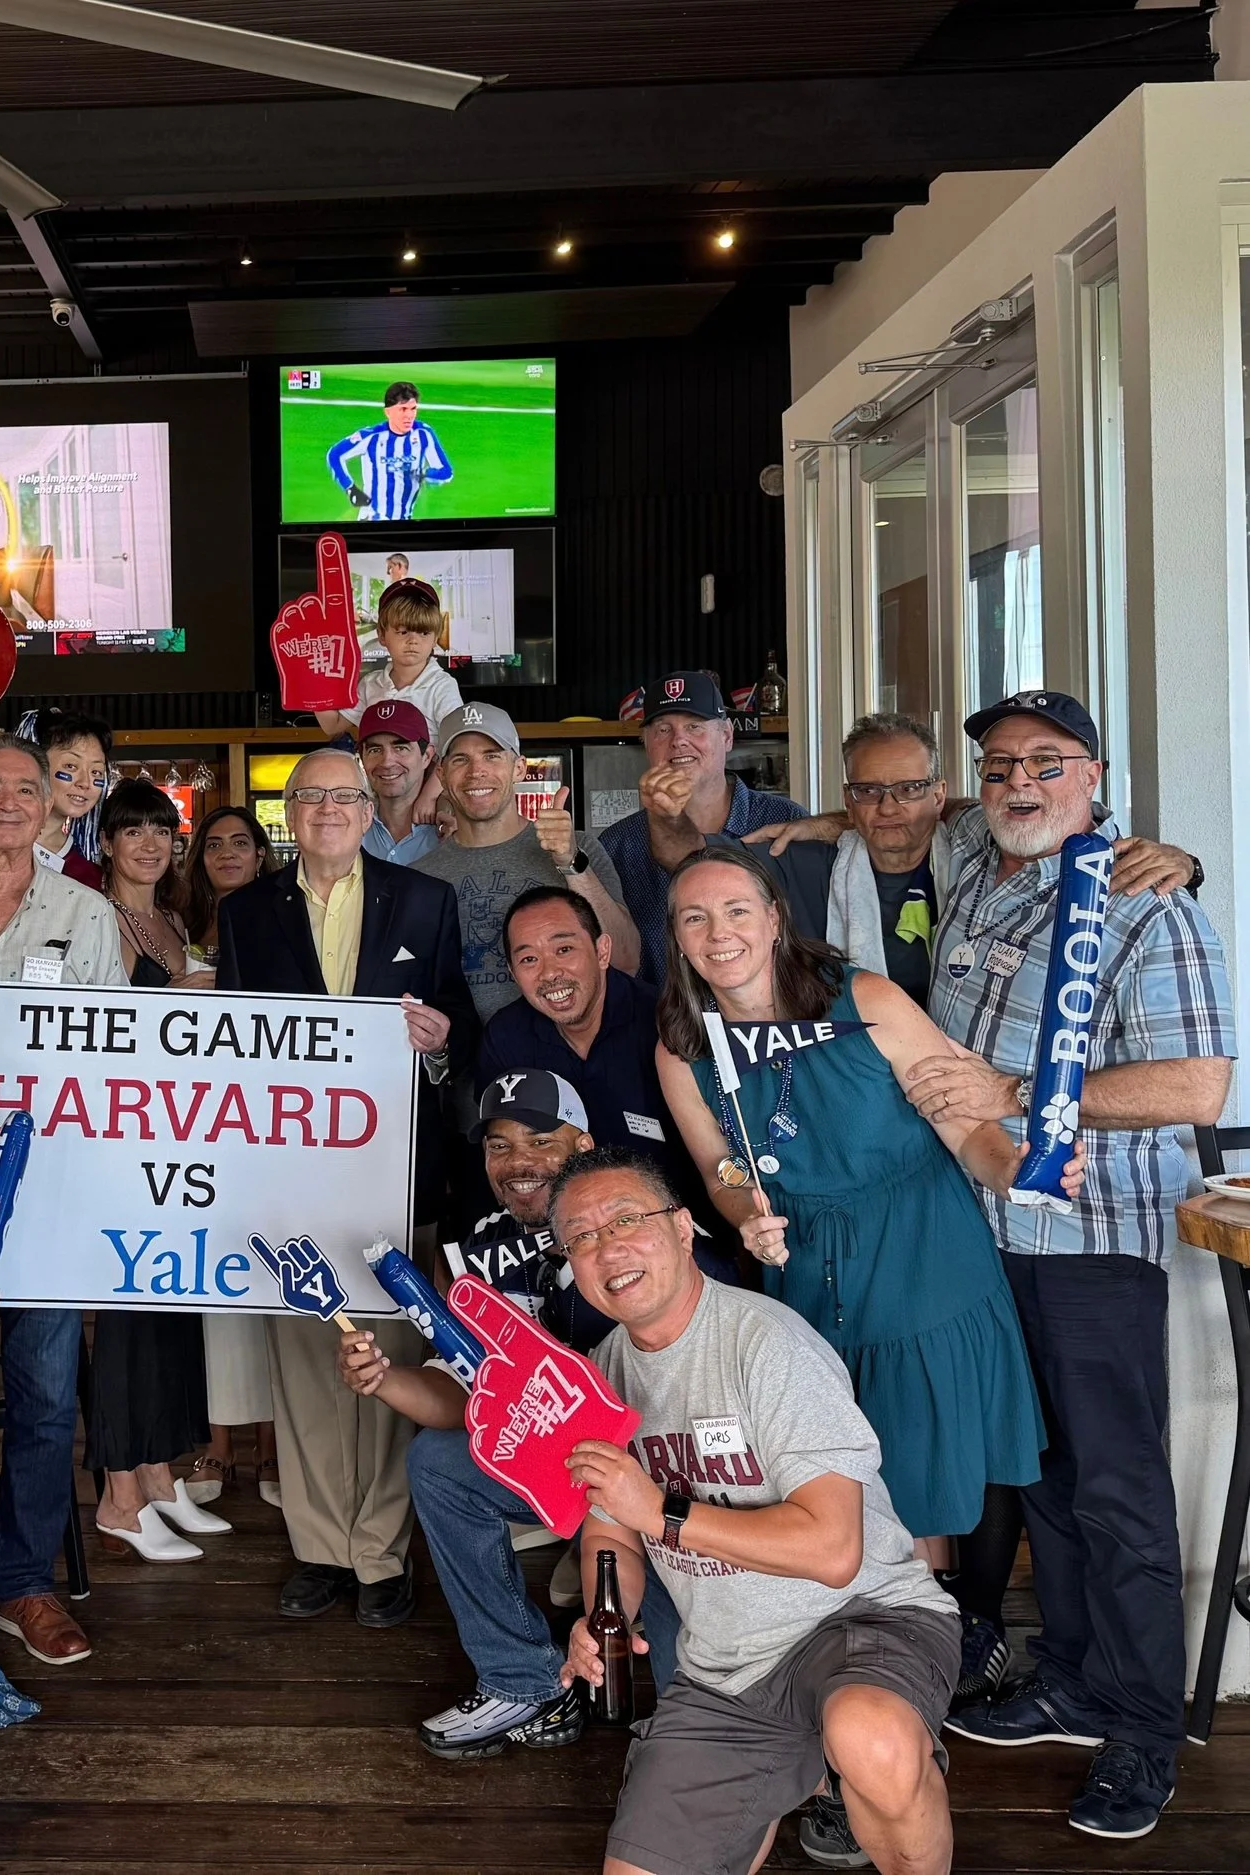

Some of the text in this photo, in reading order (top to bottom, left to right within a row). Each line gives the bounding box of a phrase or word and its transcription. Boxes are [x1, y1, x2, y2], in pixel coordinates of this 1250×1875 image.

[18, 471, 138, 484] Helps Improve Alignment
[34, 483, 124, 494] and Better Posture
[26, 619, 92, 630] 800-509-2306
[668, 681, 680, 694] H
[732, 717, 759, 731] AN
[958, 951, 966, 963] Y
[993, 942, 1016, 959] JUAN
[1050, 847, 1115, 1069] BOOLA
[20, 1004, 355, 1064] THE GAME:
[730, 1022, 836, 1065] YALE
[495, 1073, 527, 1103] Y
[141, 1162, 216, 1208] VS
[101, 1228, 250, 1297] Yale
[467, 1230, 554, 1286] YALE
[301, 1275, 334, 1308] Y
[706, 1418, 737, 1429] HARVARD
[704, 1430, 732, 1447] CHRIS
[626, 1433, 765, 1487] RVARD
[664, 1551, 701, 1578] LEAGUE
[700, 1559, 751, 1578] CHAM
